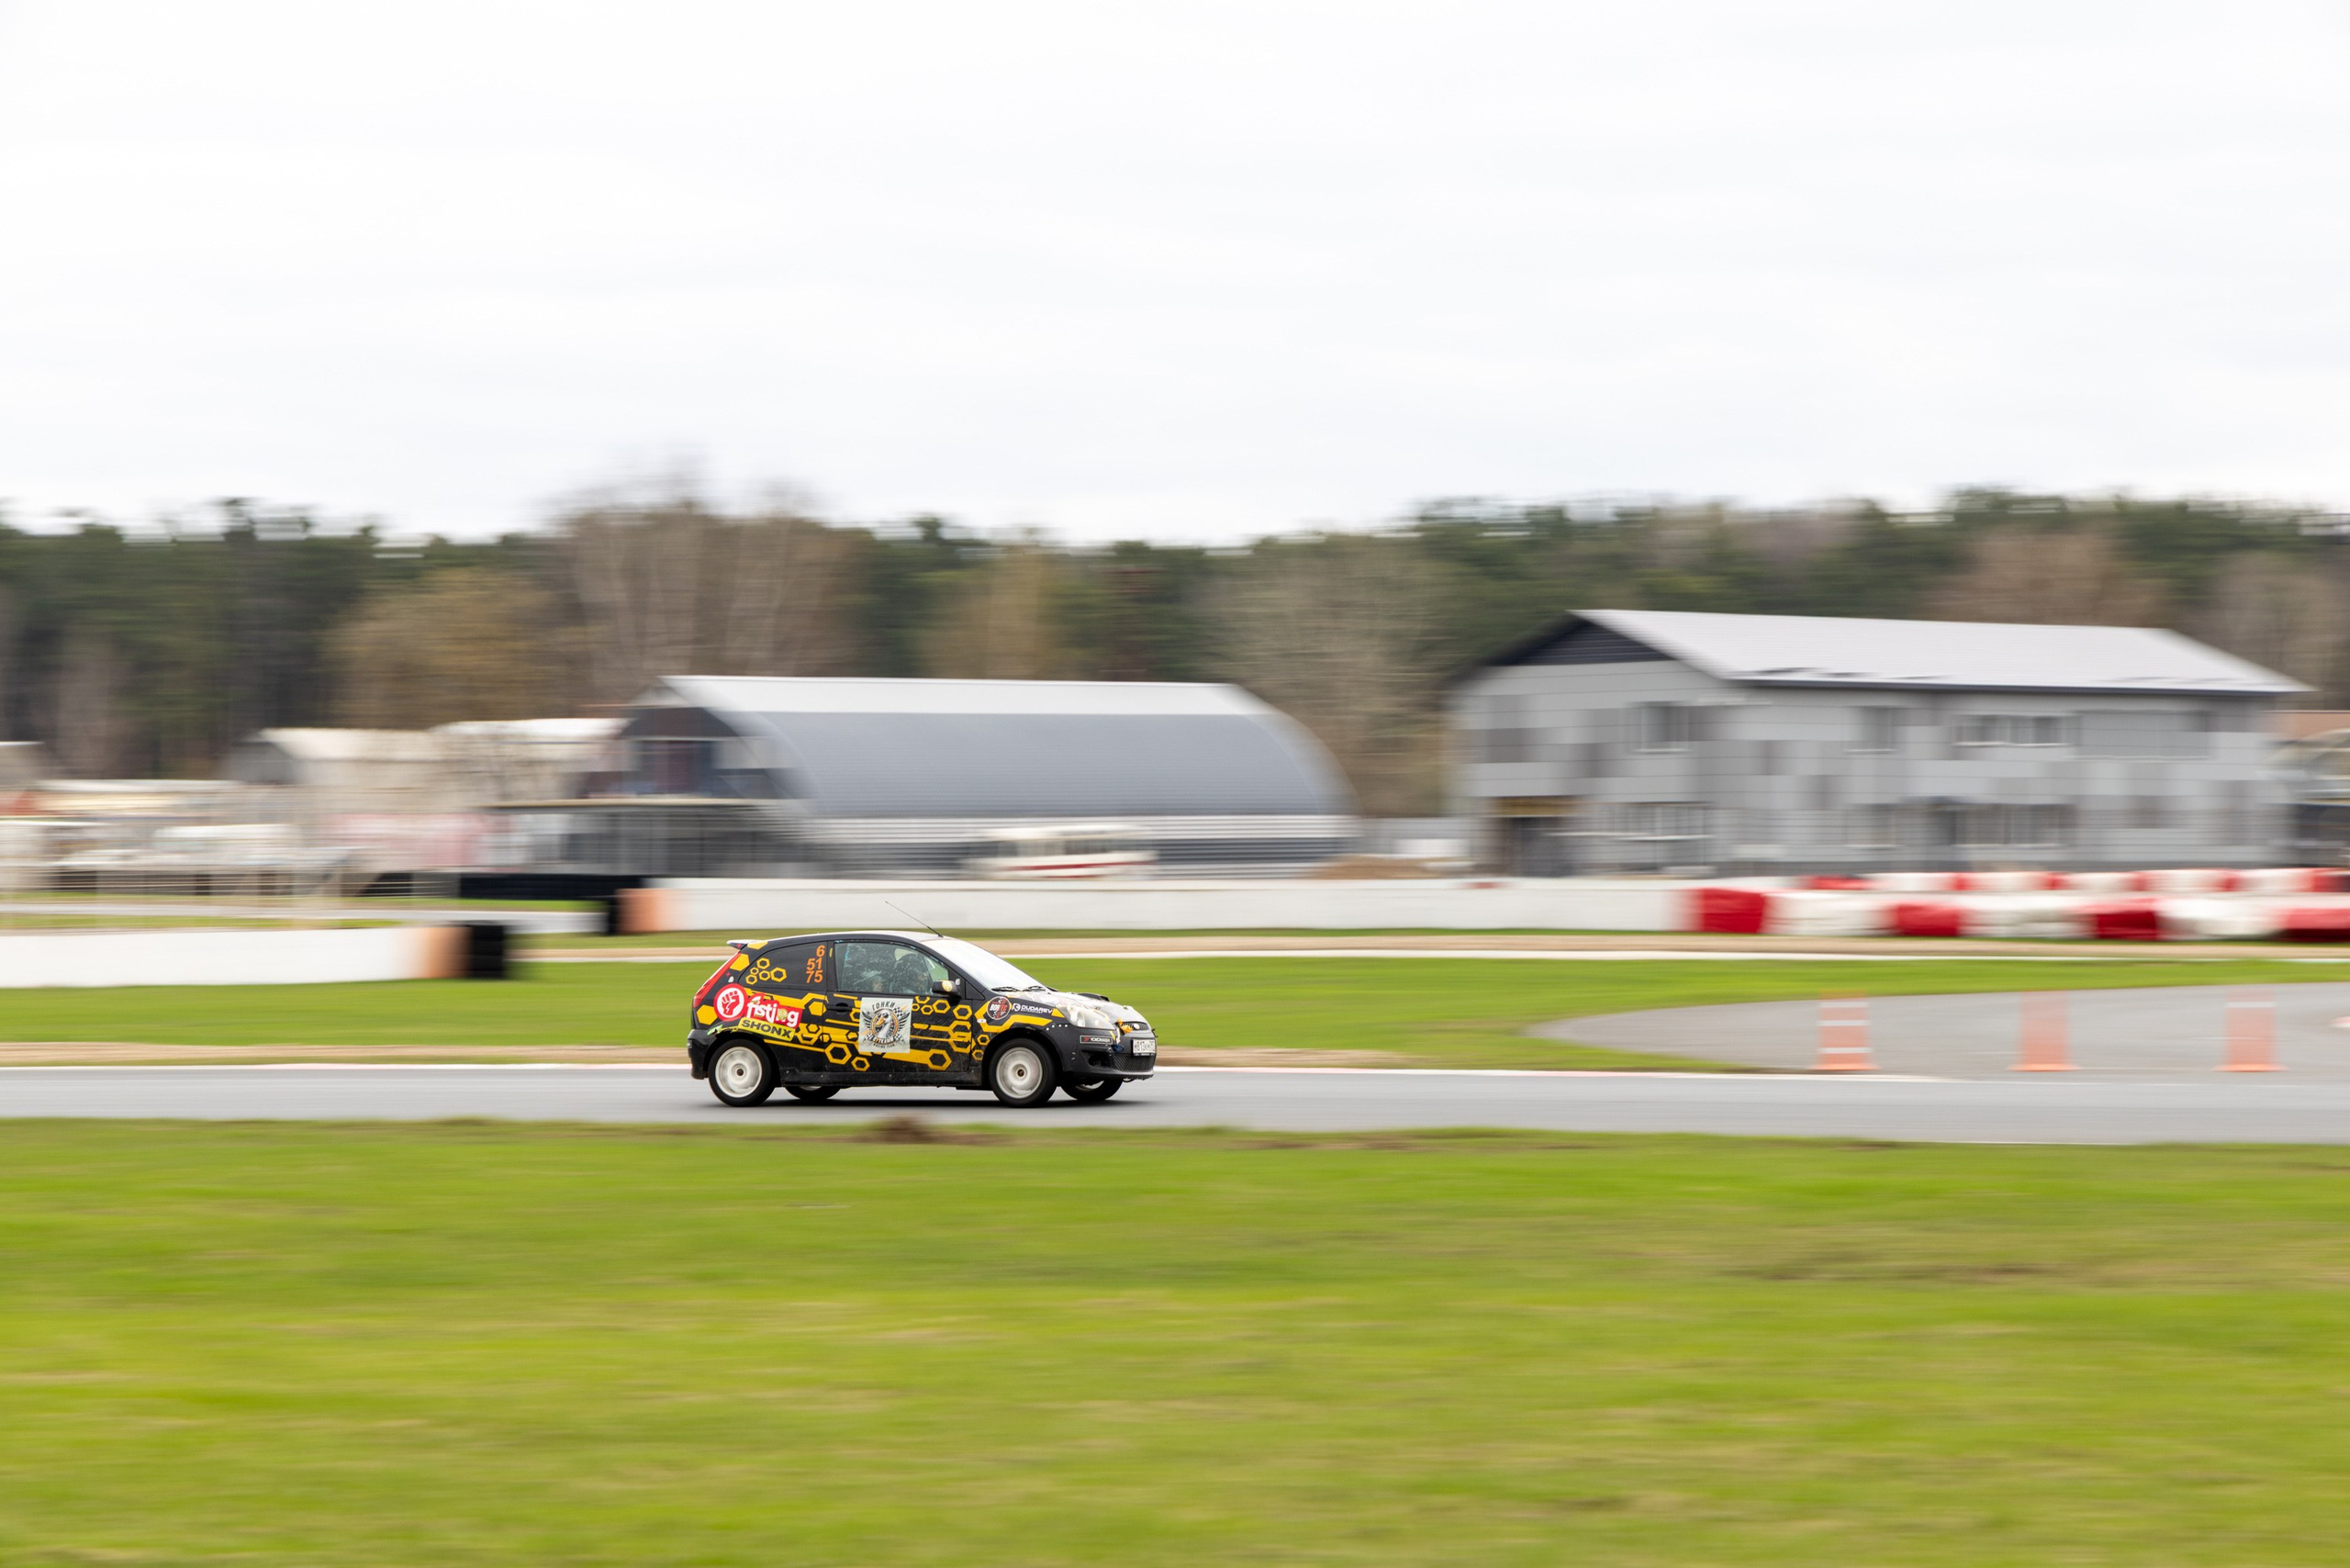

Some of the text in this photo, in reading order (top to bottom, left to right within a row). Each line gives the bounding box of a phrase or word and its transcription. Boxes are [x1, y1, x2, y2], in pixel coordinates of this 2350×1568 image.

[816, 945, 825, 958] 6
[806, 958, 822, 970] 51
[806, 969, 823, 983] 75
[747, 995, 800, 1028] fistig
[872, 1001, 896, 1012] ГОНКИ
[1021, 1004, 1053, 1014] DUDAREV
[742, 1019, 792, 1038] SHONX
